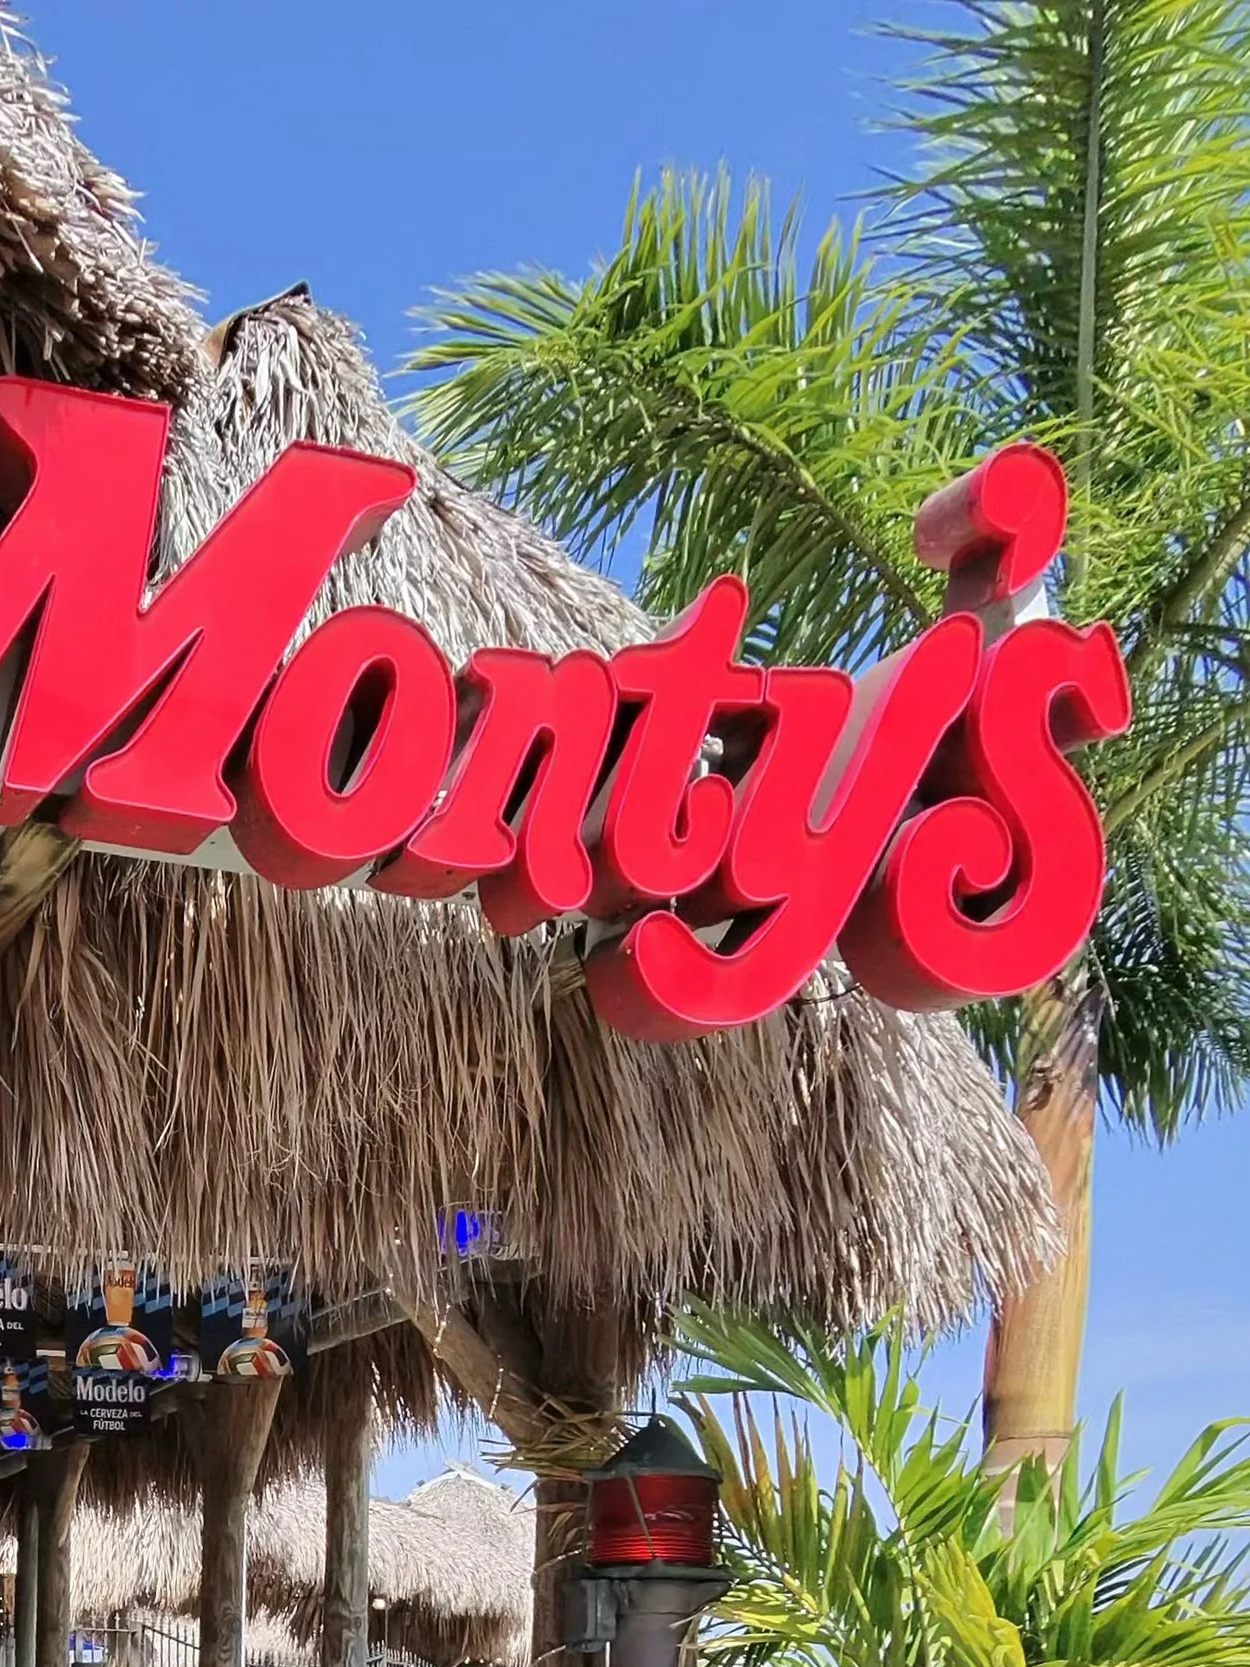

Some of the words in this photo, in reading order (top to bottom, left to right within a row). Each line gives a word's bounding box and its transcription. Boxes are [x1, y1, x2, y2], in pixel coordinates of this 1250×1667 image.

[7, 1322, 24, 1331] DEL
[76, 1376, 145, 1403] Modelo
[90, 1408, 128, 1419] CERVEZA
